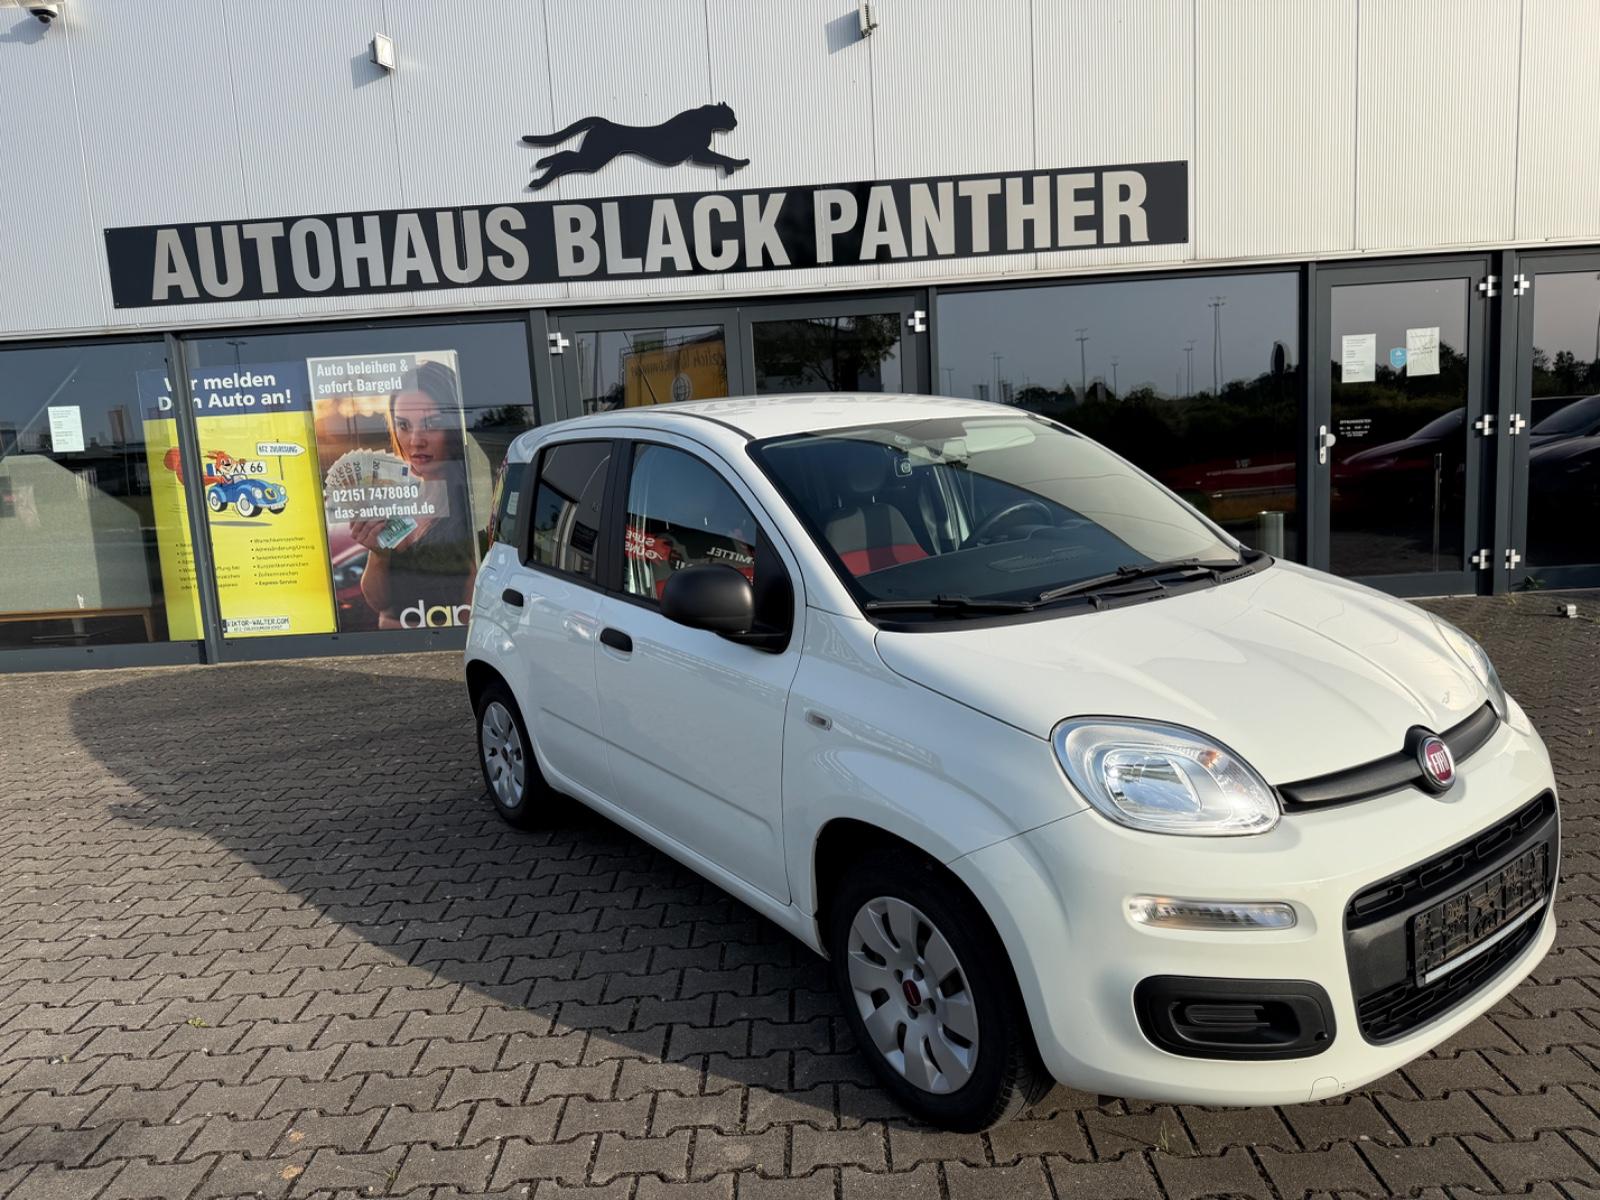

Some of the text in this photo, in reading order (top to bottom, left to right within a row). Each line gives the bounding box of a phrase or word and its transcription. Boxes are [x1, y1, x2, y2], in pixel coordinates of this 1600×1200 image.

[152, 170, 1150, 300] AUTOHAUS BLACK PANTHER
[316, 358, 409, 377] Auto beleihen &
[203, 371, 276, 390] melden
[318, 377, 403, 394] sofort Bargeld
[158, 389, 292, 411] Dn Auto an!
[250, 462, 263, 473] 66
[332, 485, 419, 503] 02151 7478080
[334, 502, 435, 519] das-autopfand.de
